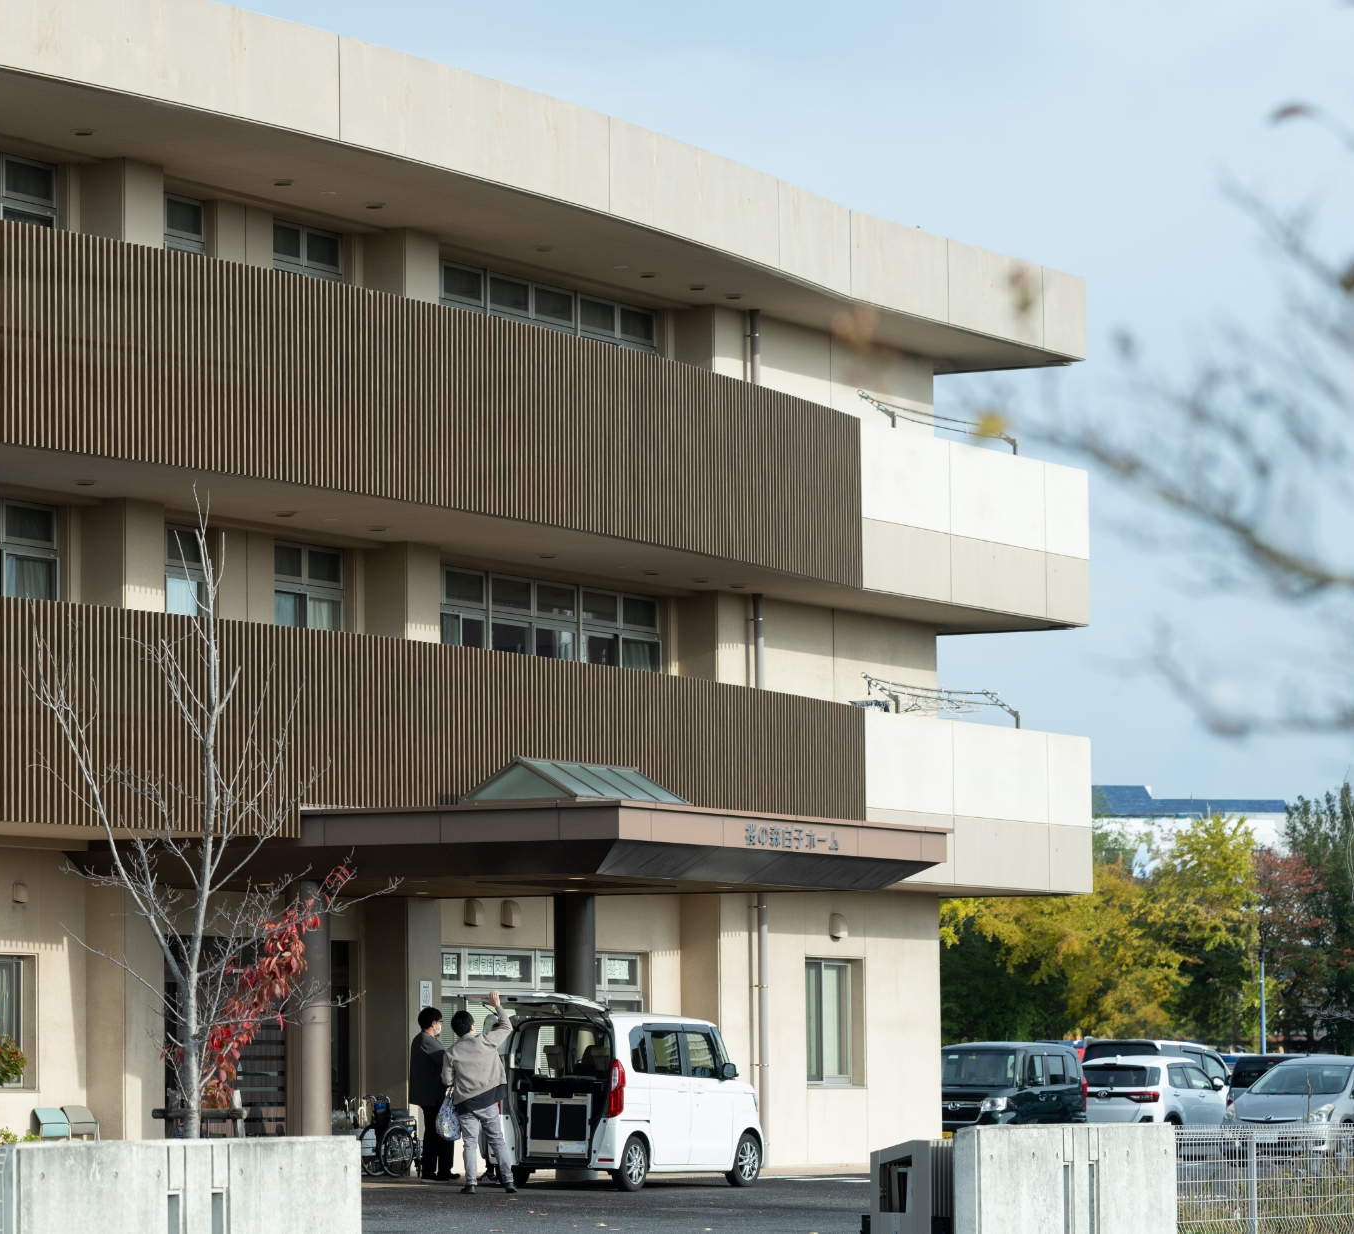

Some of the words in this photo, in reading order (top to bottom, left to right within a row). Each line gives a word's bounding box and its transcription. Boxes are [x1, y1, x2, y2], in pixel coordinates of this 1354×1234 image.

[745, 823, 839, 851] 桜の森白子ホーム
